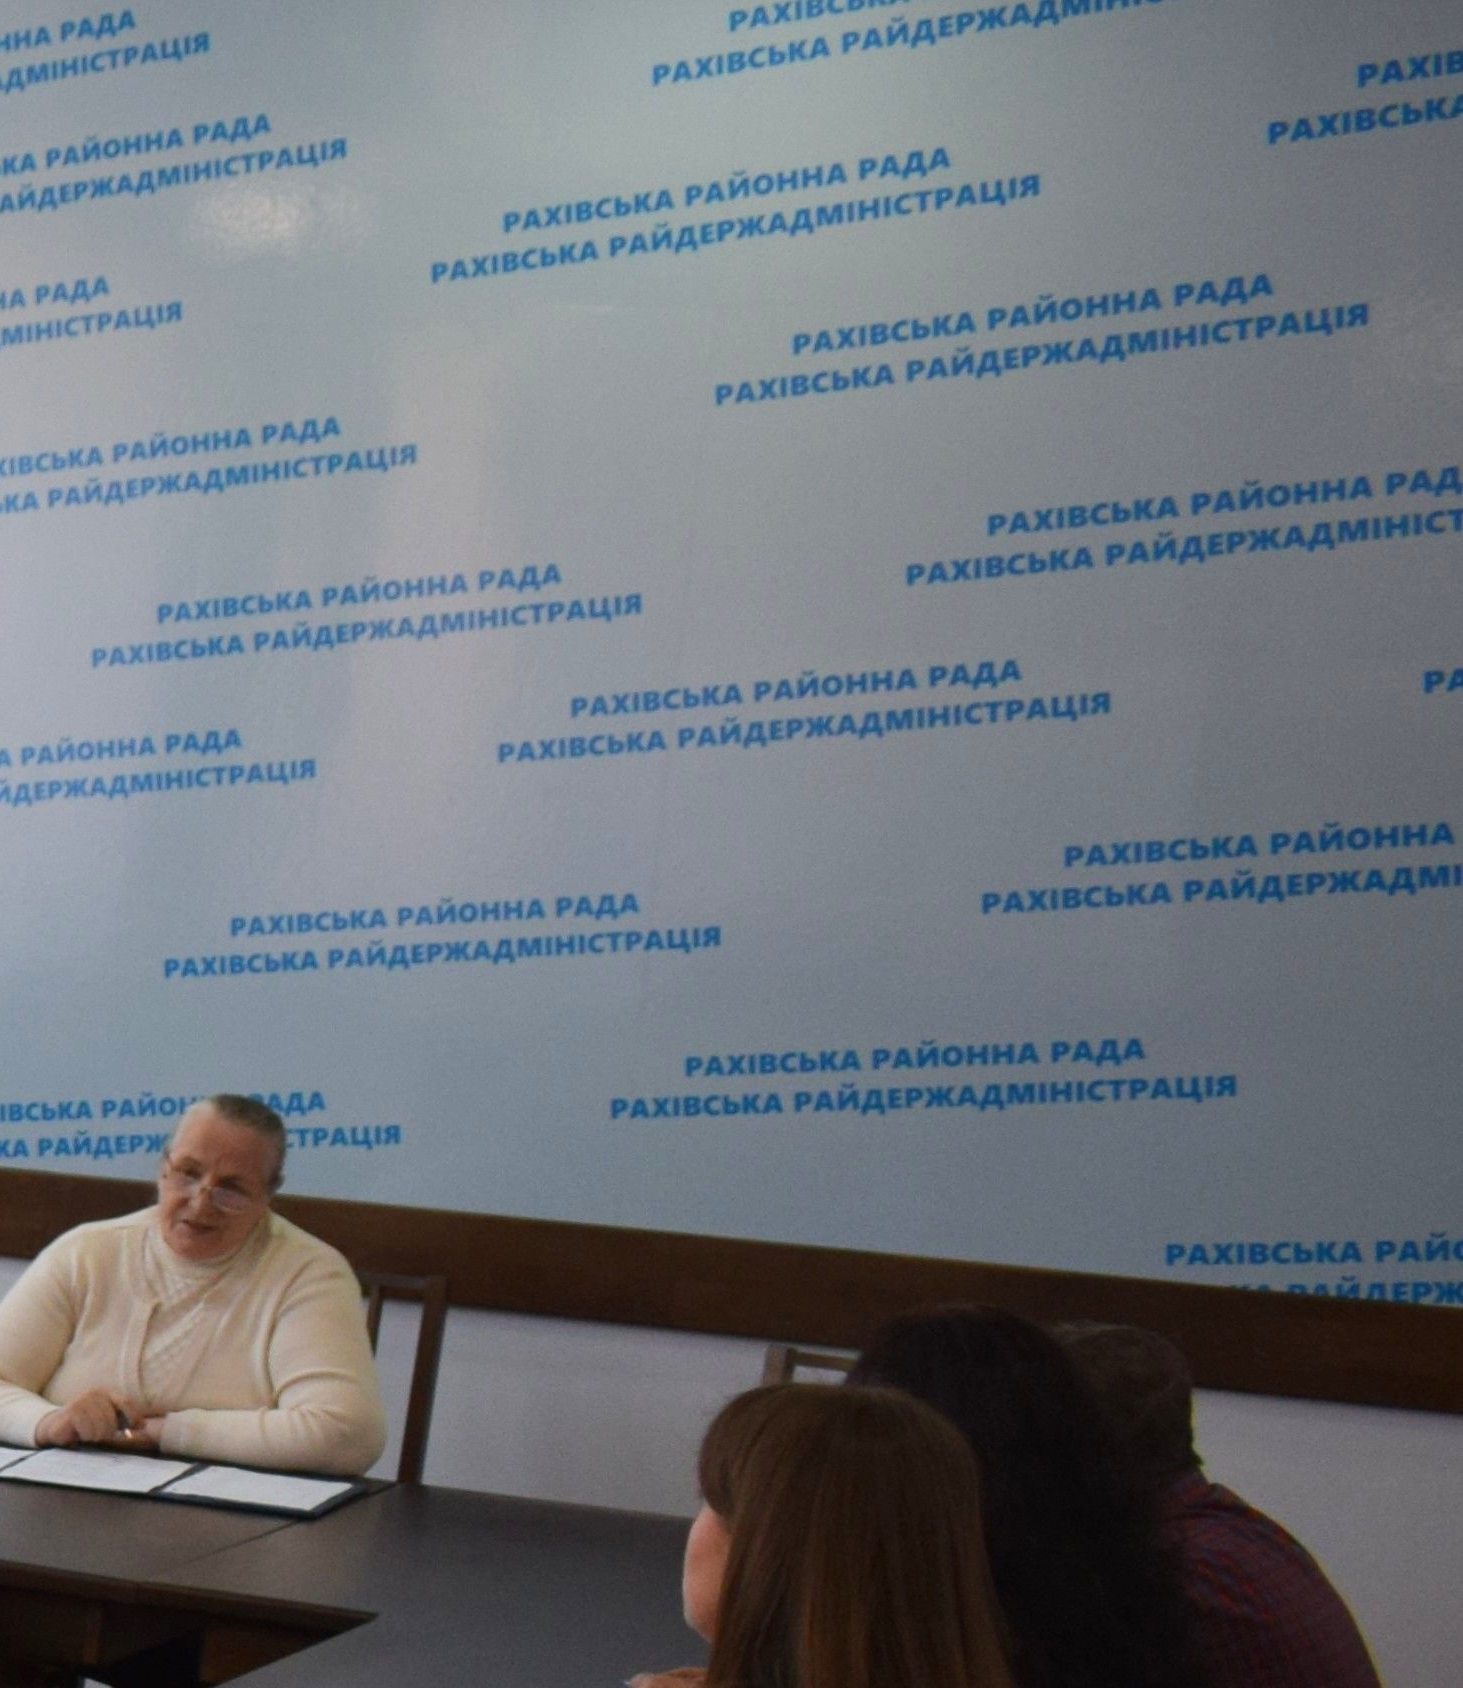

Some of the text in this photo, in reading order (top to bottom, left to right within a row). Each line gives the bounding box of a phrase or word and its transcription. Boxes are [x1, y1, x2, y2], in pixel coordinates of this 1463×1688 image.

[60, 9, 136, 42] РАДА
[650, 37, 831, 86] РАХІВСЬКА
[46, 129, 184, 167] РАЙОННА
[193, 114, 271, 144] РАДА
[501, 147, 951, 233] РАХІВСЬКА РАЙОННА РАДА
[430, 174, 1042, 283] РАХІВСЬКА РАЙДЕРЖАДМІНІСТРАЦІЯ
[35, 277, 110, 304] РАДА
[790, 273, 1274, 356] РАХІВСЬКА РАЙОННА РАДА
[714, 303, 1370, 406] РАХІВСЬКА РАЙДЕРЖАДМІНІСТРАЦІЯ
[113, 427, 252, 461] РАЙОННА
[261, 417, 341, 444] РАДА
[48, 444, 418, 506] РАЙДЕРЖАДМІНІСТРАЦІЯ
[986, 496, 1180, 536] РАХІВСЬКА
[1188, 475, 1373, 516] РАЙОННА
[904, 546, 1095, 586] РАХІВСЬКА
[157, 564, 562, 623] РАХІВСЬКА РАЙОННА РАДА
[91, 593, 643, 667] РАХІВСЬКА РАЙДЕРЖАДМІНІСТРАЦІЯ
[570, 658, 1022, 717] РАХІВСЬКА РАЙОННА РАДА
[21, 736, 156, 764] РАЙОННА
[165, 728, 243, 755] РАДА
[497, 691, 1112, 762] РАХІВСЬКА РАЙДЕРЖАДМІНІСТРАЦІЯ
[1063, 821, 1456, 869] РАХІВСЬКА РАЙОННА
[229, 893, 640, 937] РАХІВСЬКА РАЙОННА РАДА
[980, 882, 1173, 916] РАХІВСЬКА
[163, 925, 723, 979] РАХІВСЬКА РАЙДЕРЖАДМІНІСТРАЦІЯ
[683, 1037, 1146, 1078] РАХІВСЬКА РАЙОННА РАДА
[610, 1074, 1238, 1120] РАХІВСЬКА РАЙДЕРЖАДМІНІСТРАЦІЯ
[1163, 1240, 1364, 1268] РАХІВСЬКА
